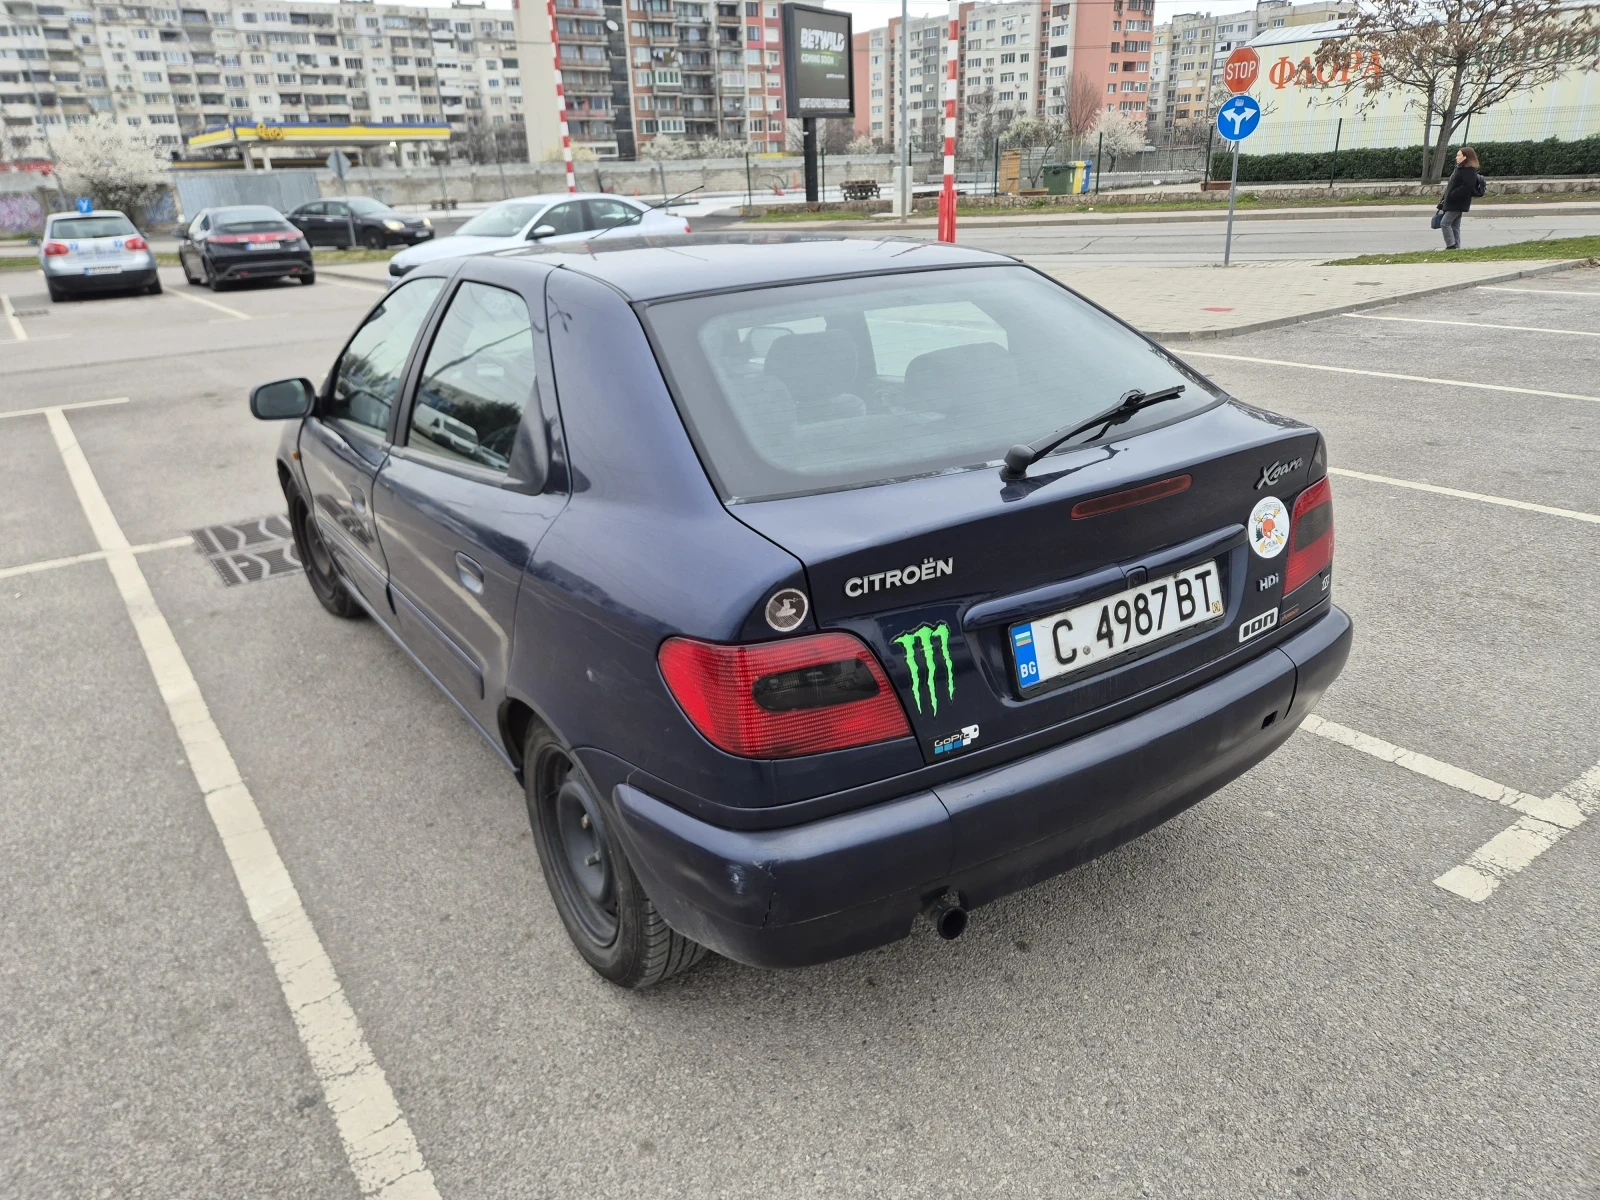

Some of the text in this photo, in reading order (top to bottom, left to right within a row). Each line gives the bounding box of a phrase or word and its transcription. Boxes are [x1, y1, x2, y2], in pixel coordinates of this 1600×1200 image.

[800, 28, 845, 52] BETWILD
[801, 53, 835, 65] COMING SOON
[1225, 60, 1257, 81] STOP
[1256, 457, 1302, 490] Xsara
[844, 557, 954, 598] CITROËN
[1257, 572, 1279, 592] HDi
[1019, 661, 1037, 679] BG
